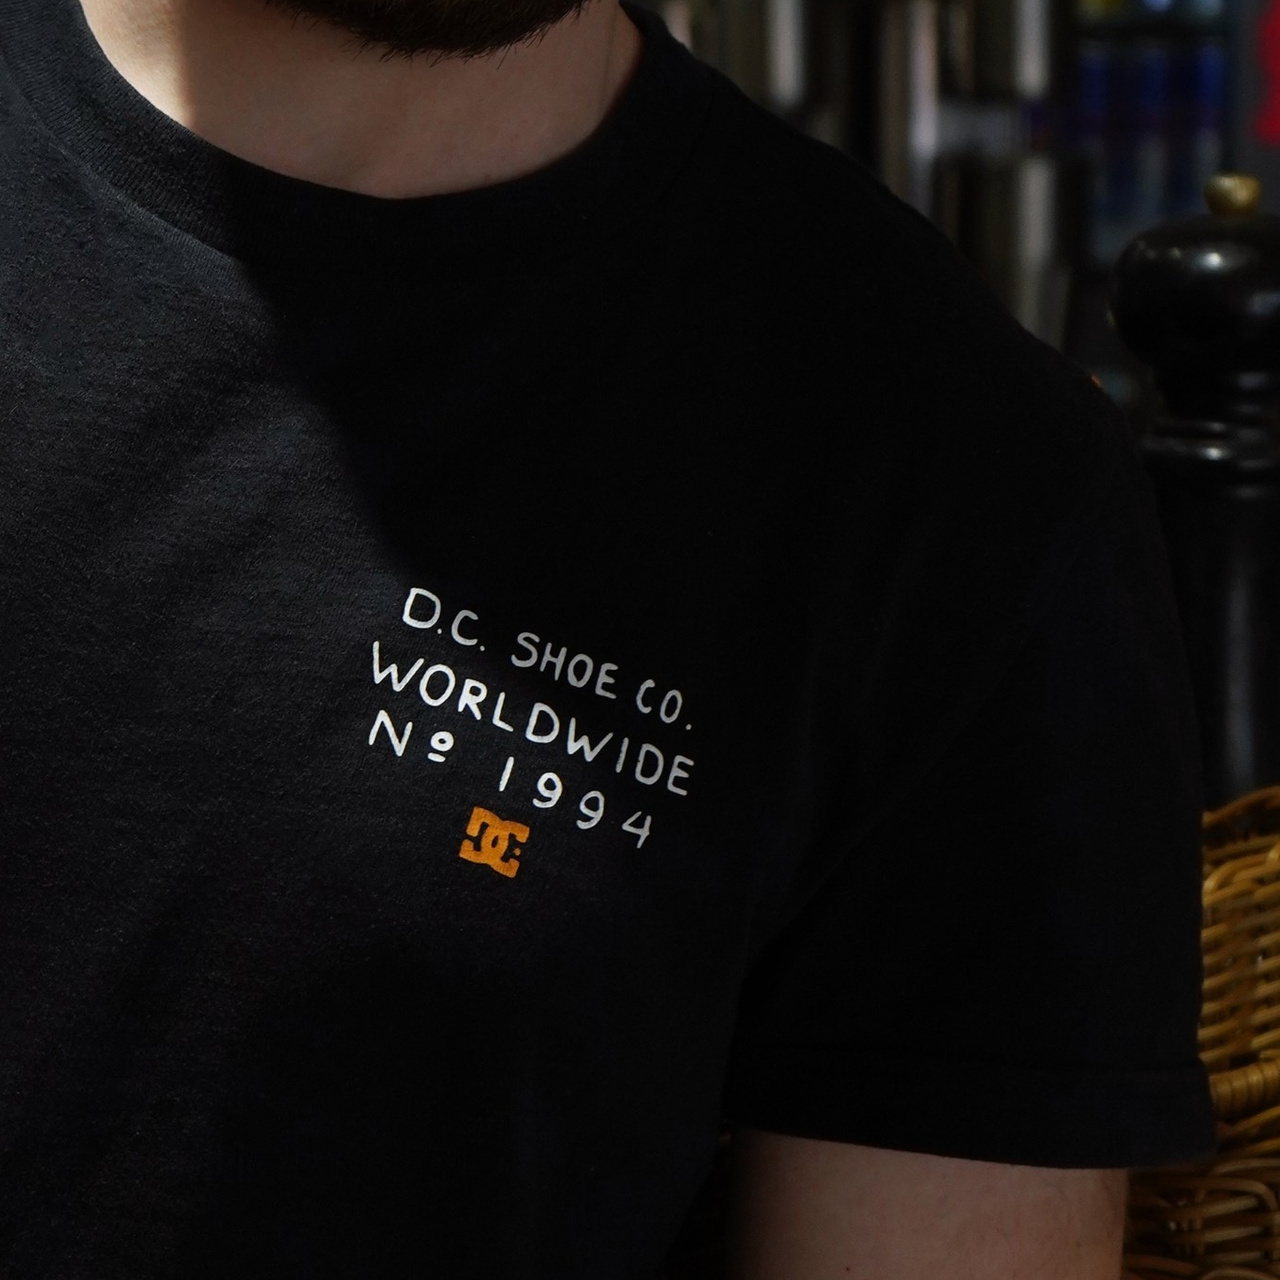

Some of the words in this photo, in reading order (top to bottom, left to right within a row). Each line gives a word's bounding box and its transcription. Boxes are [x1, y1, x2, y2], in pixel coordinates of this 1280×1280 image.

[372, 640, 696, 797] WORLDWIDE
[402, 586, 486, 652] D.C.
[510, 631, 620, 700] SHOE
[635, 678, 694, 731] CO.
[498, 756, 653, 850] 1994
